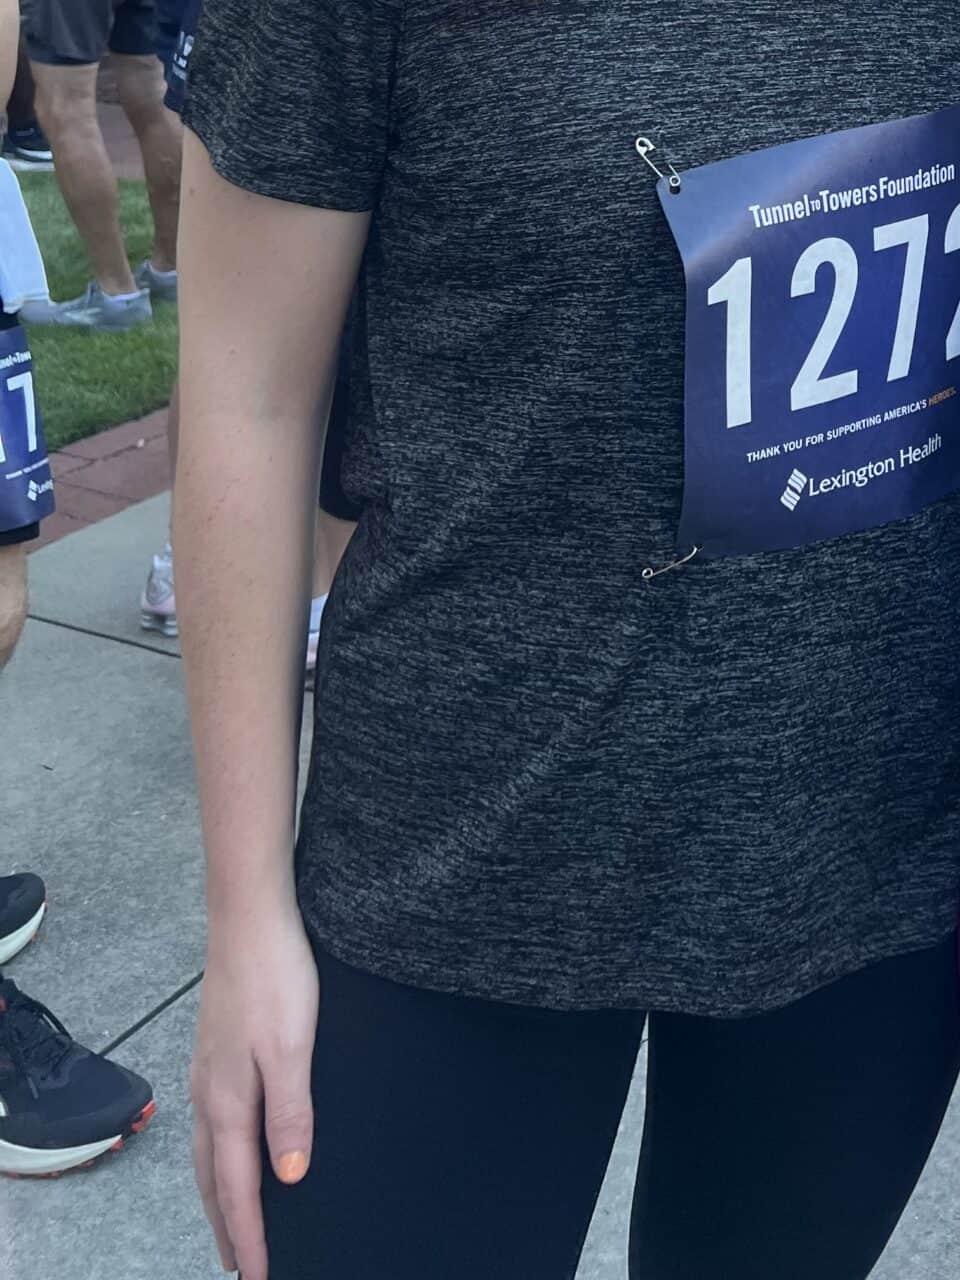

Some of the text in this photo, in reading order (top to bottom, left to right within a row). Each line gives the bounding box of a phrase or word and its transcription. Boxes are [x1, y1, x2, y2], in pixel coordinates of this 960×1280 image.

[748, 194, 810, 228] Tunnel
[819, 183, 877, 213] Towers
[879, 163, 955, 200] Foundation
[746, 445, 781, 463] THANK
[783, 439, 803, 454] YOU
[805, 433, 824, 450] FOR
[826, 414, 882, 441] SUPPORTING
[883, 399, 927, 422] AMERICA'S
[808, 432, 942, 497] Lexington Health
